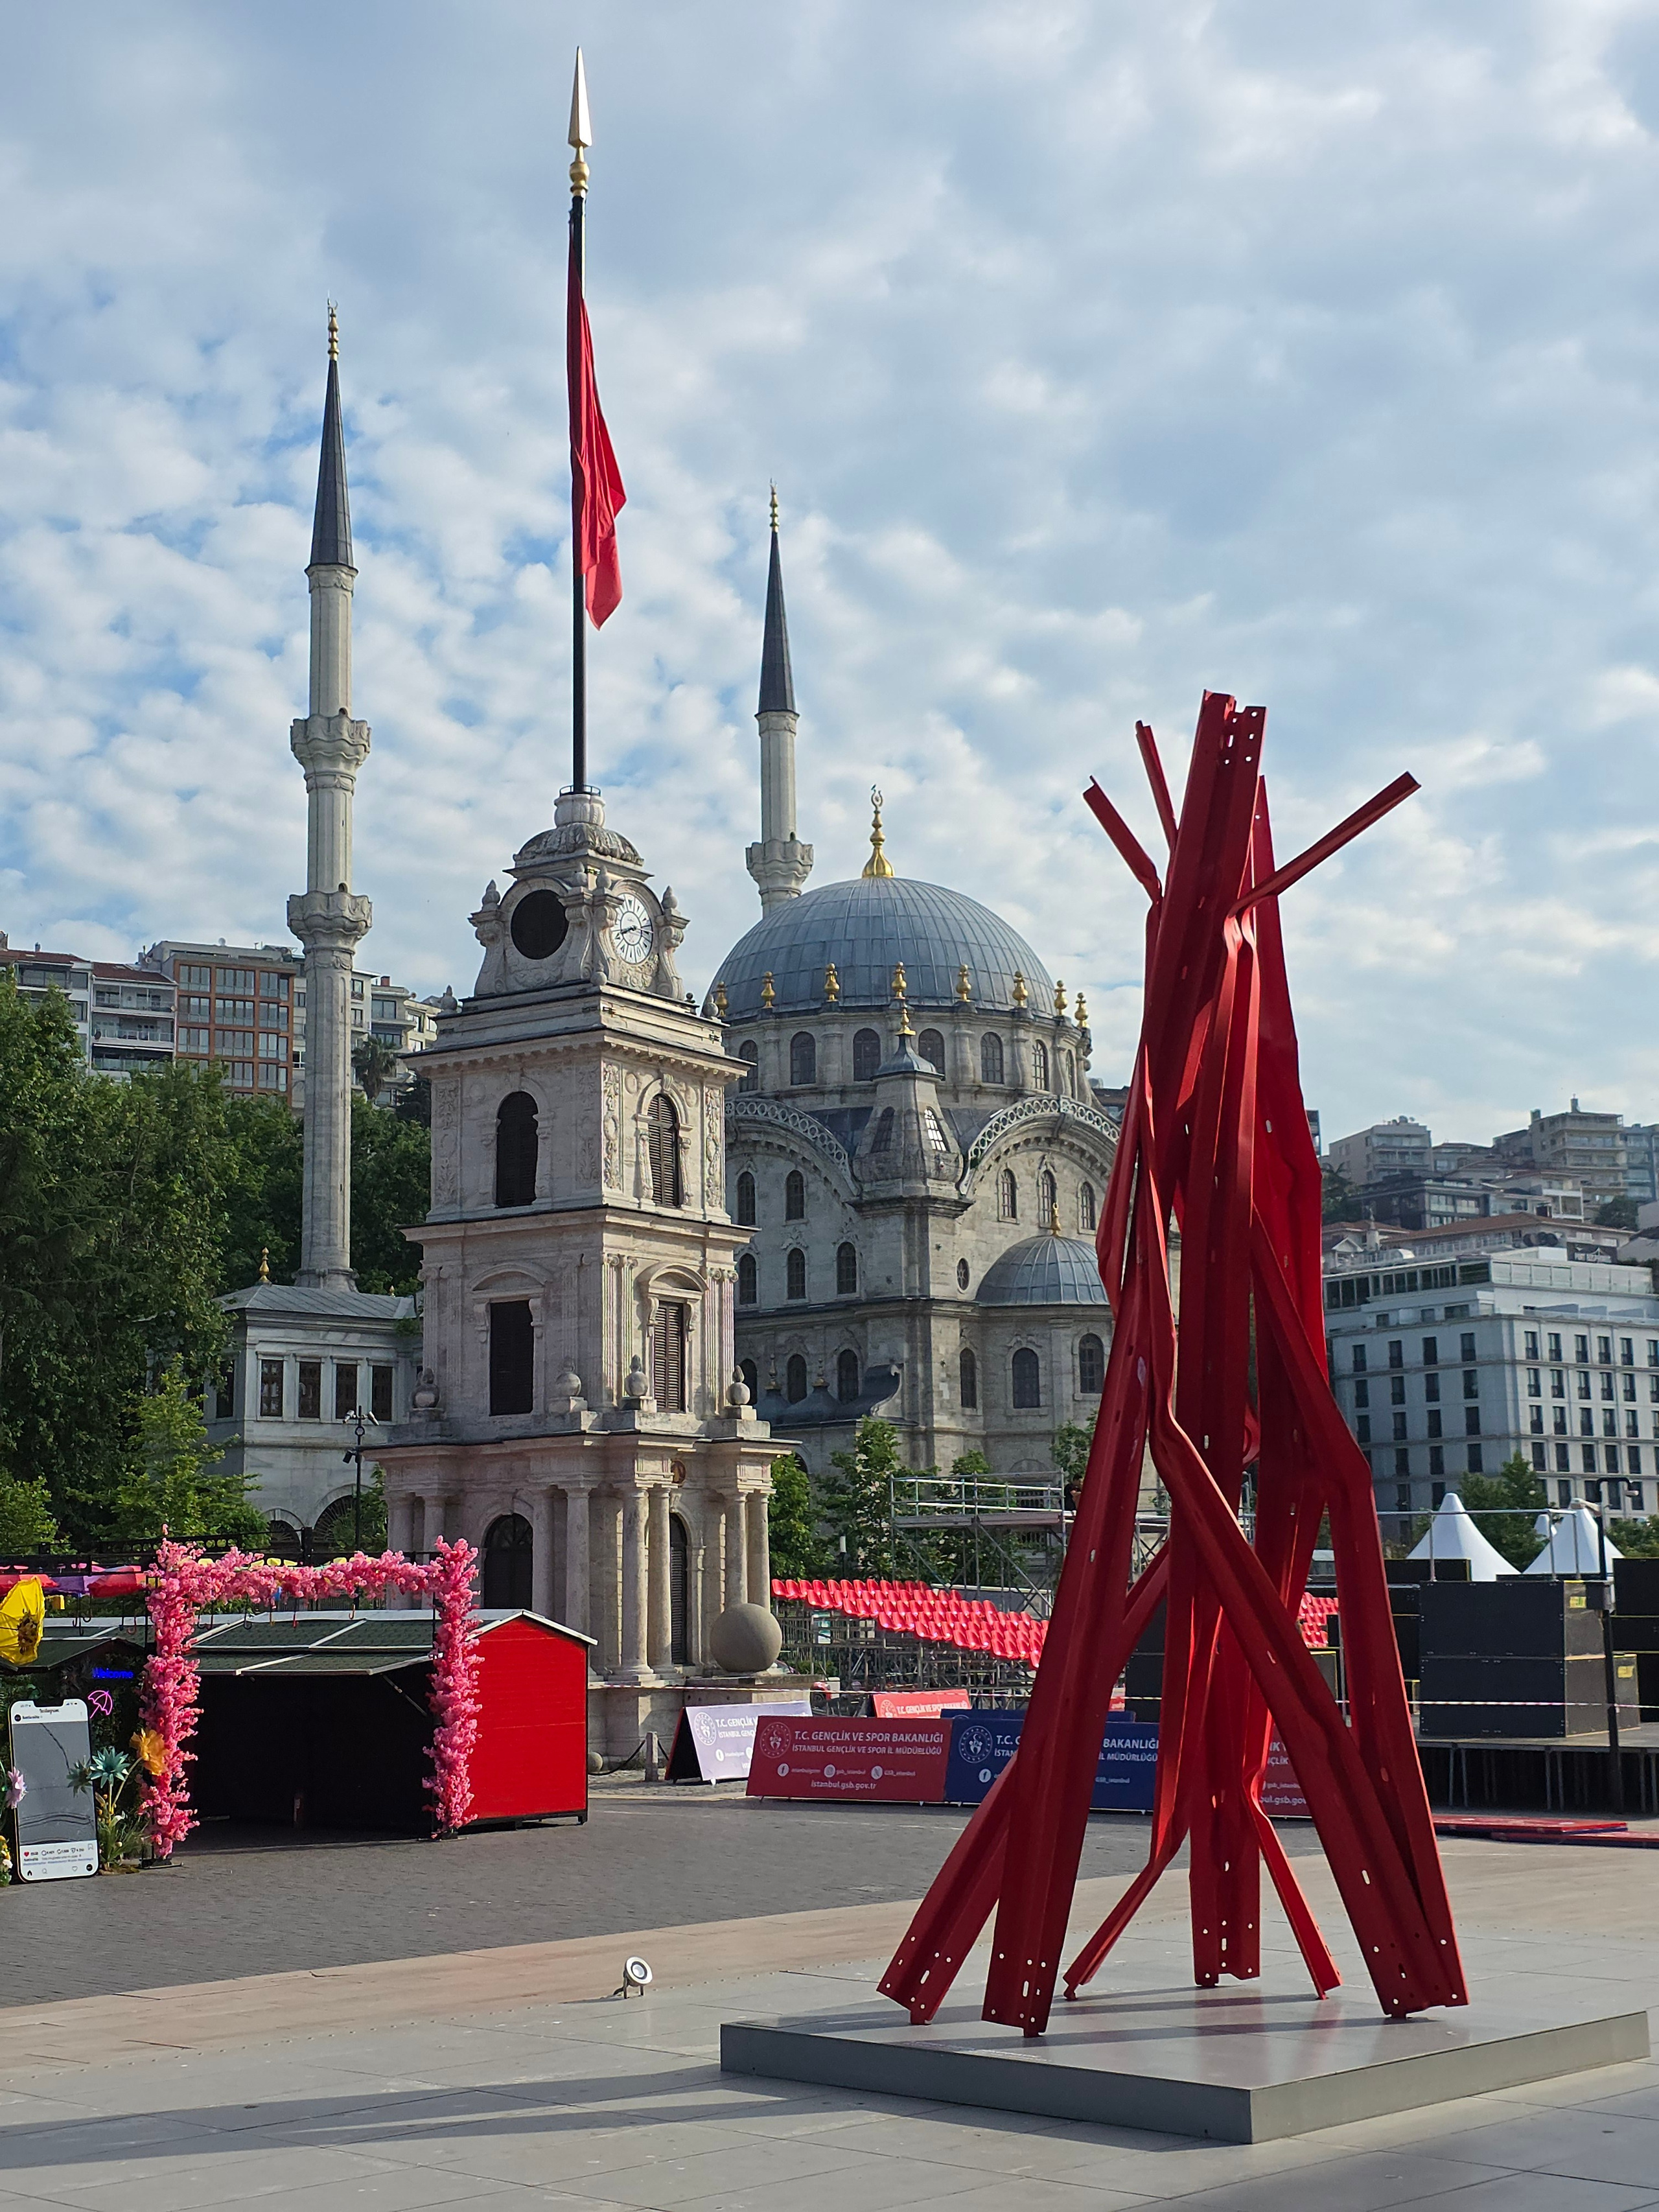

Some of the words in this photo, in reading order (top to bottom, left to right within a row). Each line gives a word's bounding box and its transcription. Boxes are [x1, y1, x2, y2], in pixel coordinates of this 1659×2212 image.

[715, 1719, 727, 1728] T.C.
[727, 1716, 753, 1729] GENÇLİK
[795, 1730, 809, 1740] T.C.
[811, 1730, 850, 1743] GENÇLİK
[852, 1732, 864, 1741] VE
[865, 1732, 890, 1742] SPOR
[892, 1731, 944, 1743] BAKANLIĞI
[996, 1735, 1013, 1745] T.C.
[793, 1743, 825, 1752] İSTANBUL
[826, 1745, 855, 1754] GENÇLİK
[867, 1746, 886, 1754] SPOR
[888, 1746, 894, 1754] İL
[1103, 1738, 1159, 1749] BAKANLIĞI
[1107, 1752, 1158, 1762] MÜDÜRLÜĞÜ
[811, 1780, 877, 1790] istanbul.gsb.gov.tr
